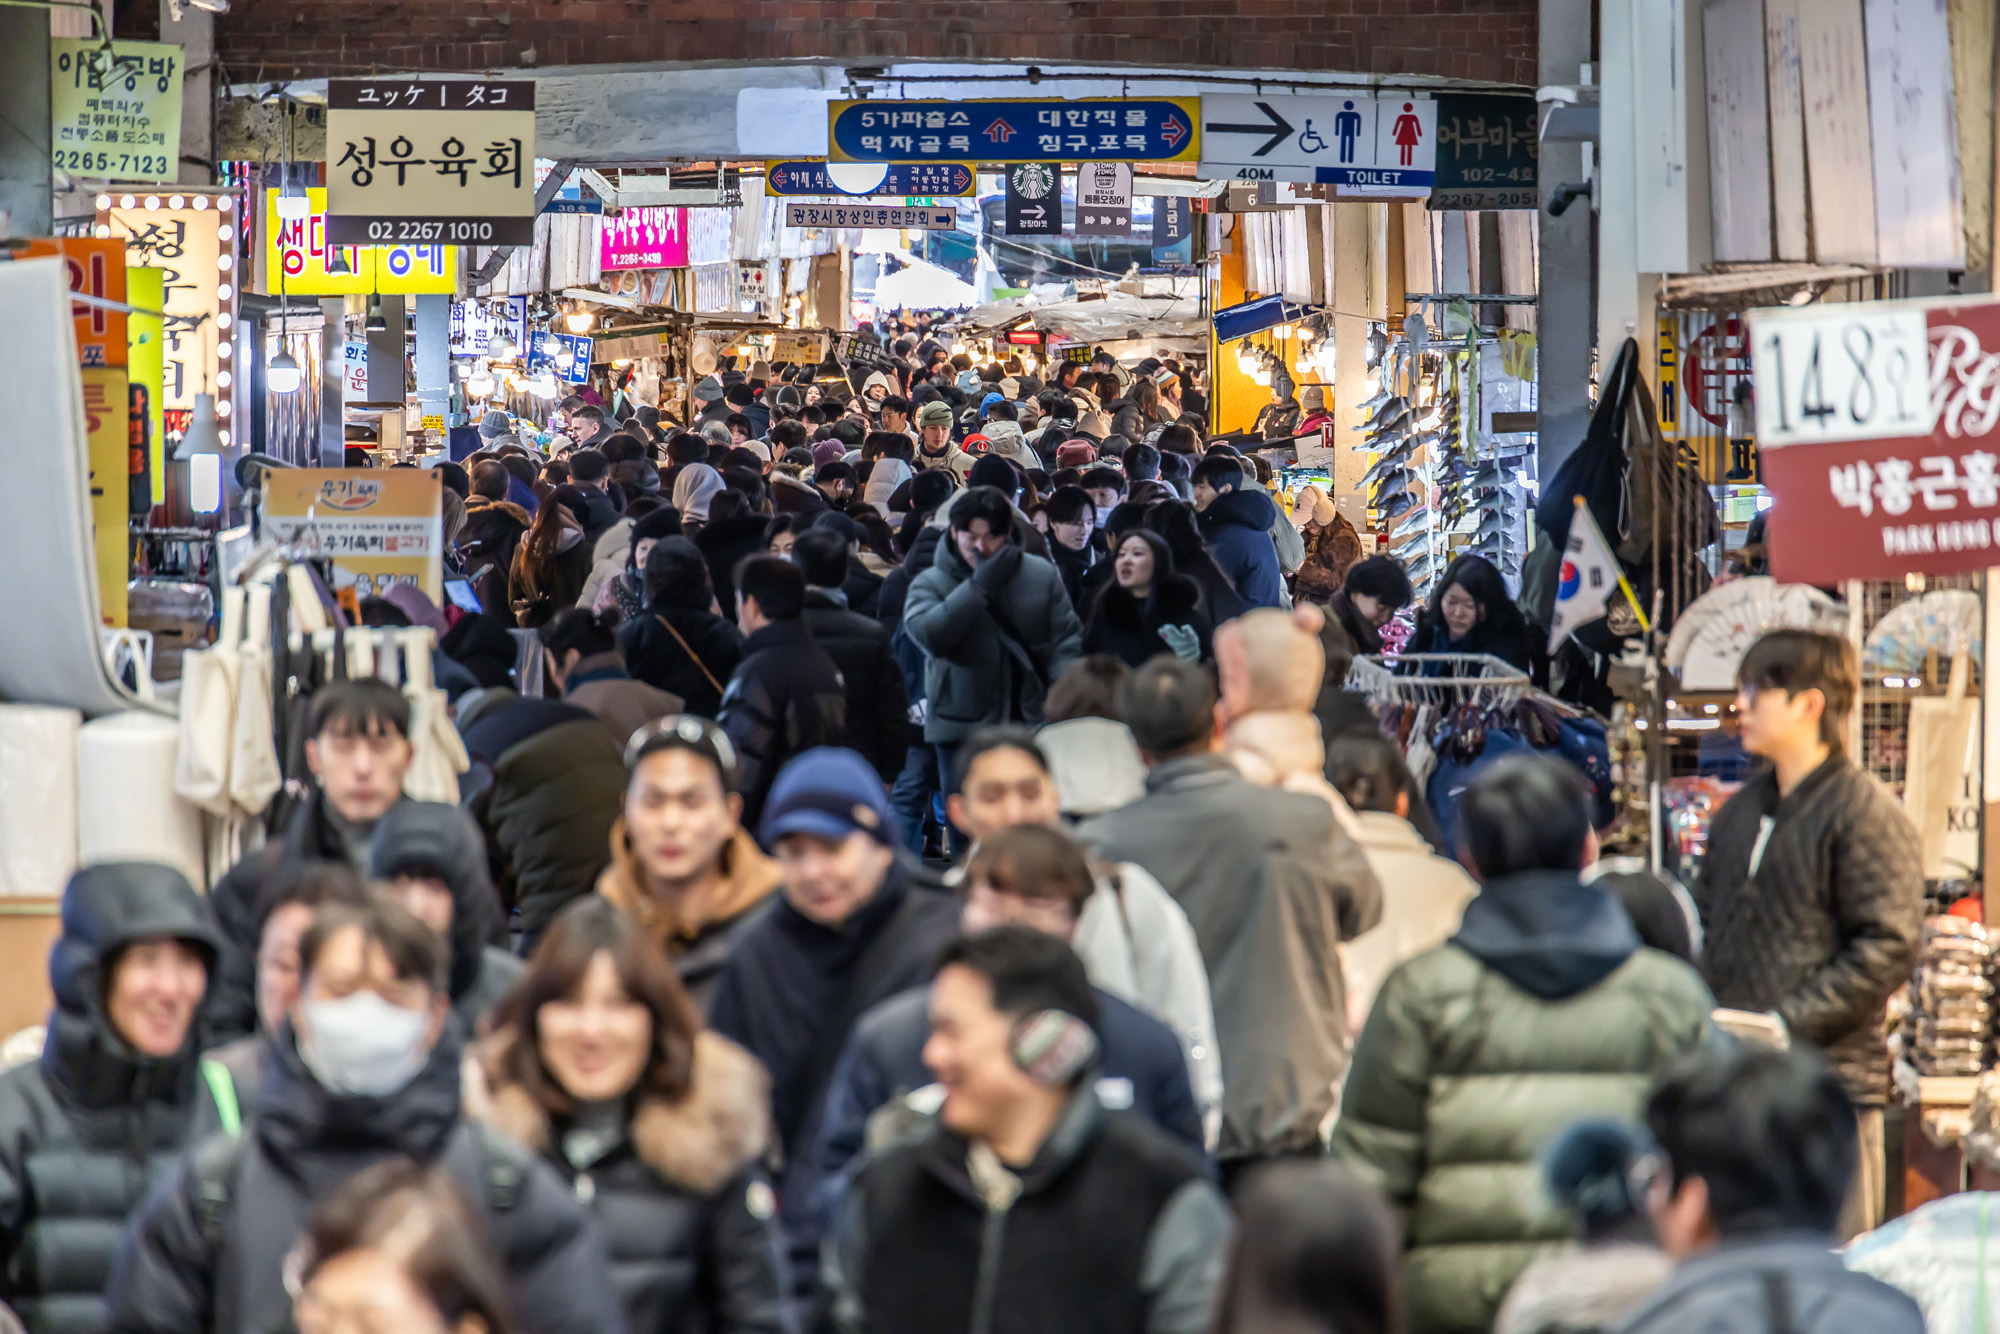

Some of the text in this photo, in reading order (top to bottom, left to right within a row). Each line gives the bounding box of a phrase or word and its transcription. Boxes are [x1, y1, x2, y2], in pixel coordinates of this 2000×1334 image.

[59, 51, 175, 93] 이공방
[358, 85, 507, 106] ユッケ タコ
[861, 111, 970, 129] 5가파출소
[1038, 109, 1148, 128] 대한직물
[861, 136, 970, 153] 먹자골목
[1038, 134, 1147, 153] 침구,포목
[55, 150, 167, 174] 2265-7123
[336, 135, 523, 189] 성우육회
[1236, 167, 1274, 180] 40M
[1346, 171, 1402, 185] TOILET
[1461, 168, 1535, 182] 102-4호
[1439, 192, 1538, 206] 2267-205
[793, 208, 930, 227] 광장시장상인총연합회
[368, 221, 493, 241] 02 2267 1010
